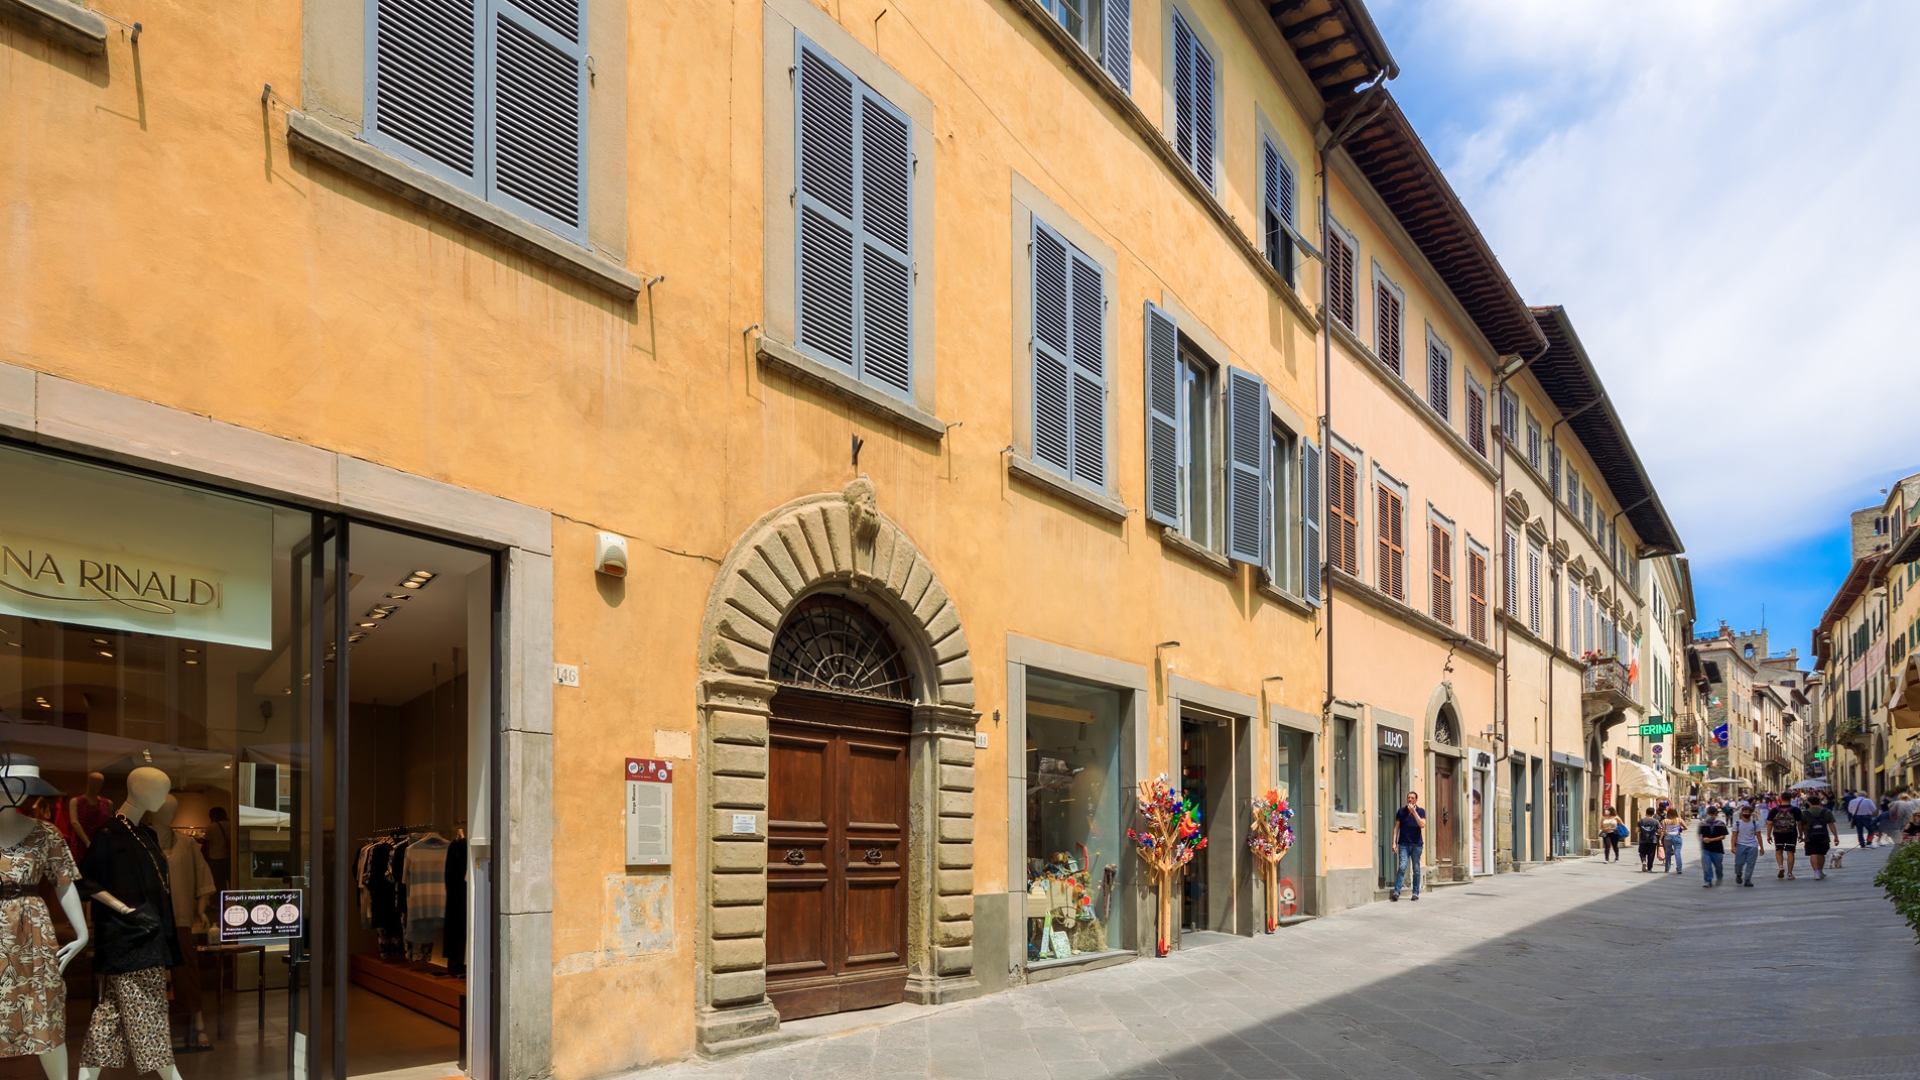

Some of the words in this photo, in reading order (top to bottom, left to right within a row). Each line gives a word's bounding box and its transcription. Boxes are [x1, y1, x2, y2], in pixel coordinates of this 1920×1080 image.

[79, 559, 224, 611] RINALDI
[556, 667, 578, 683] 146
[225, 894, 243, 902] Scopri
